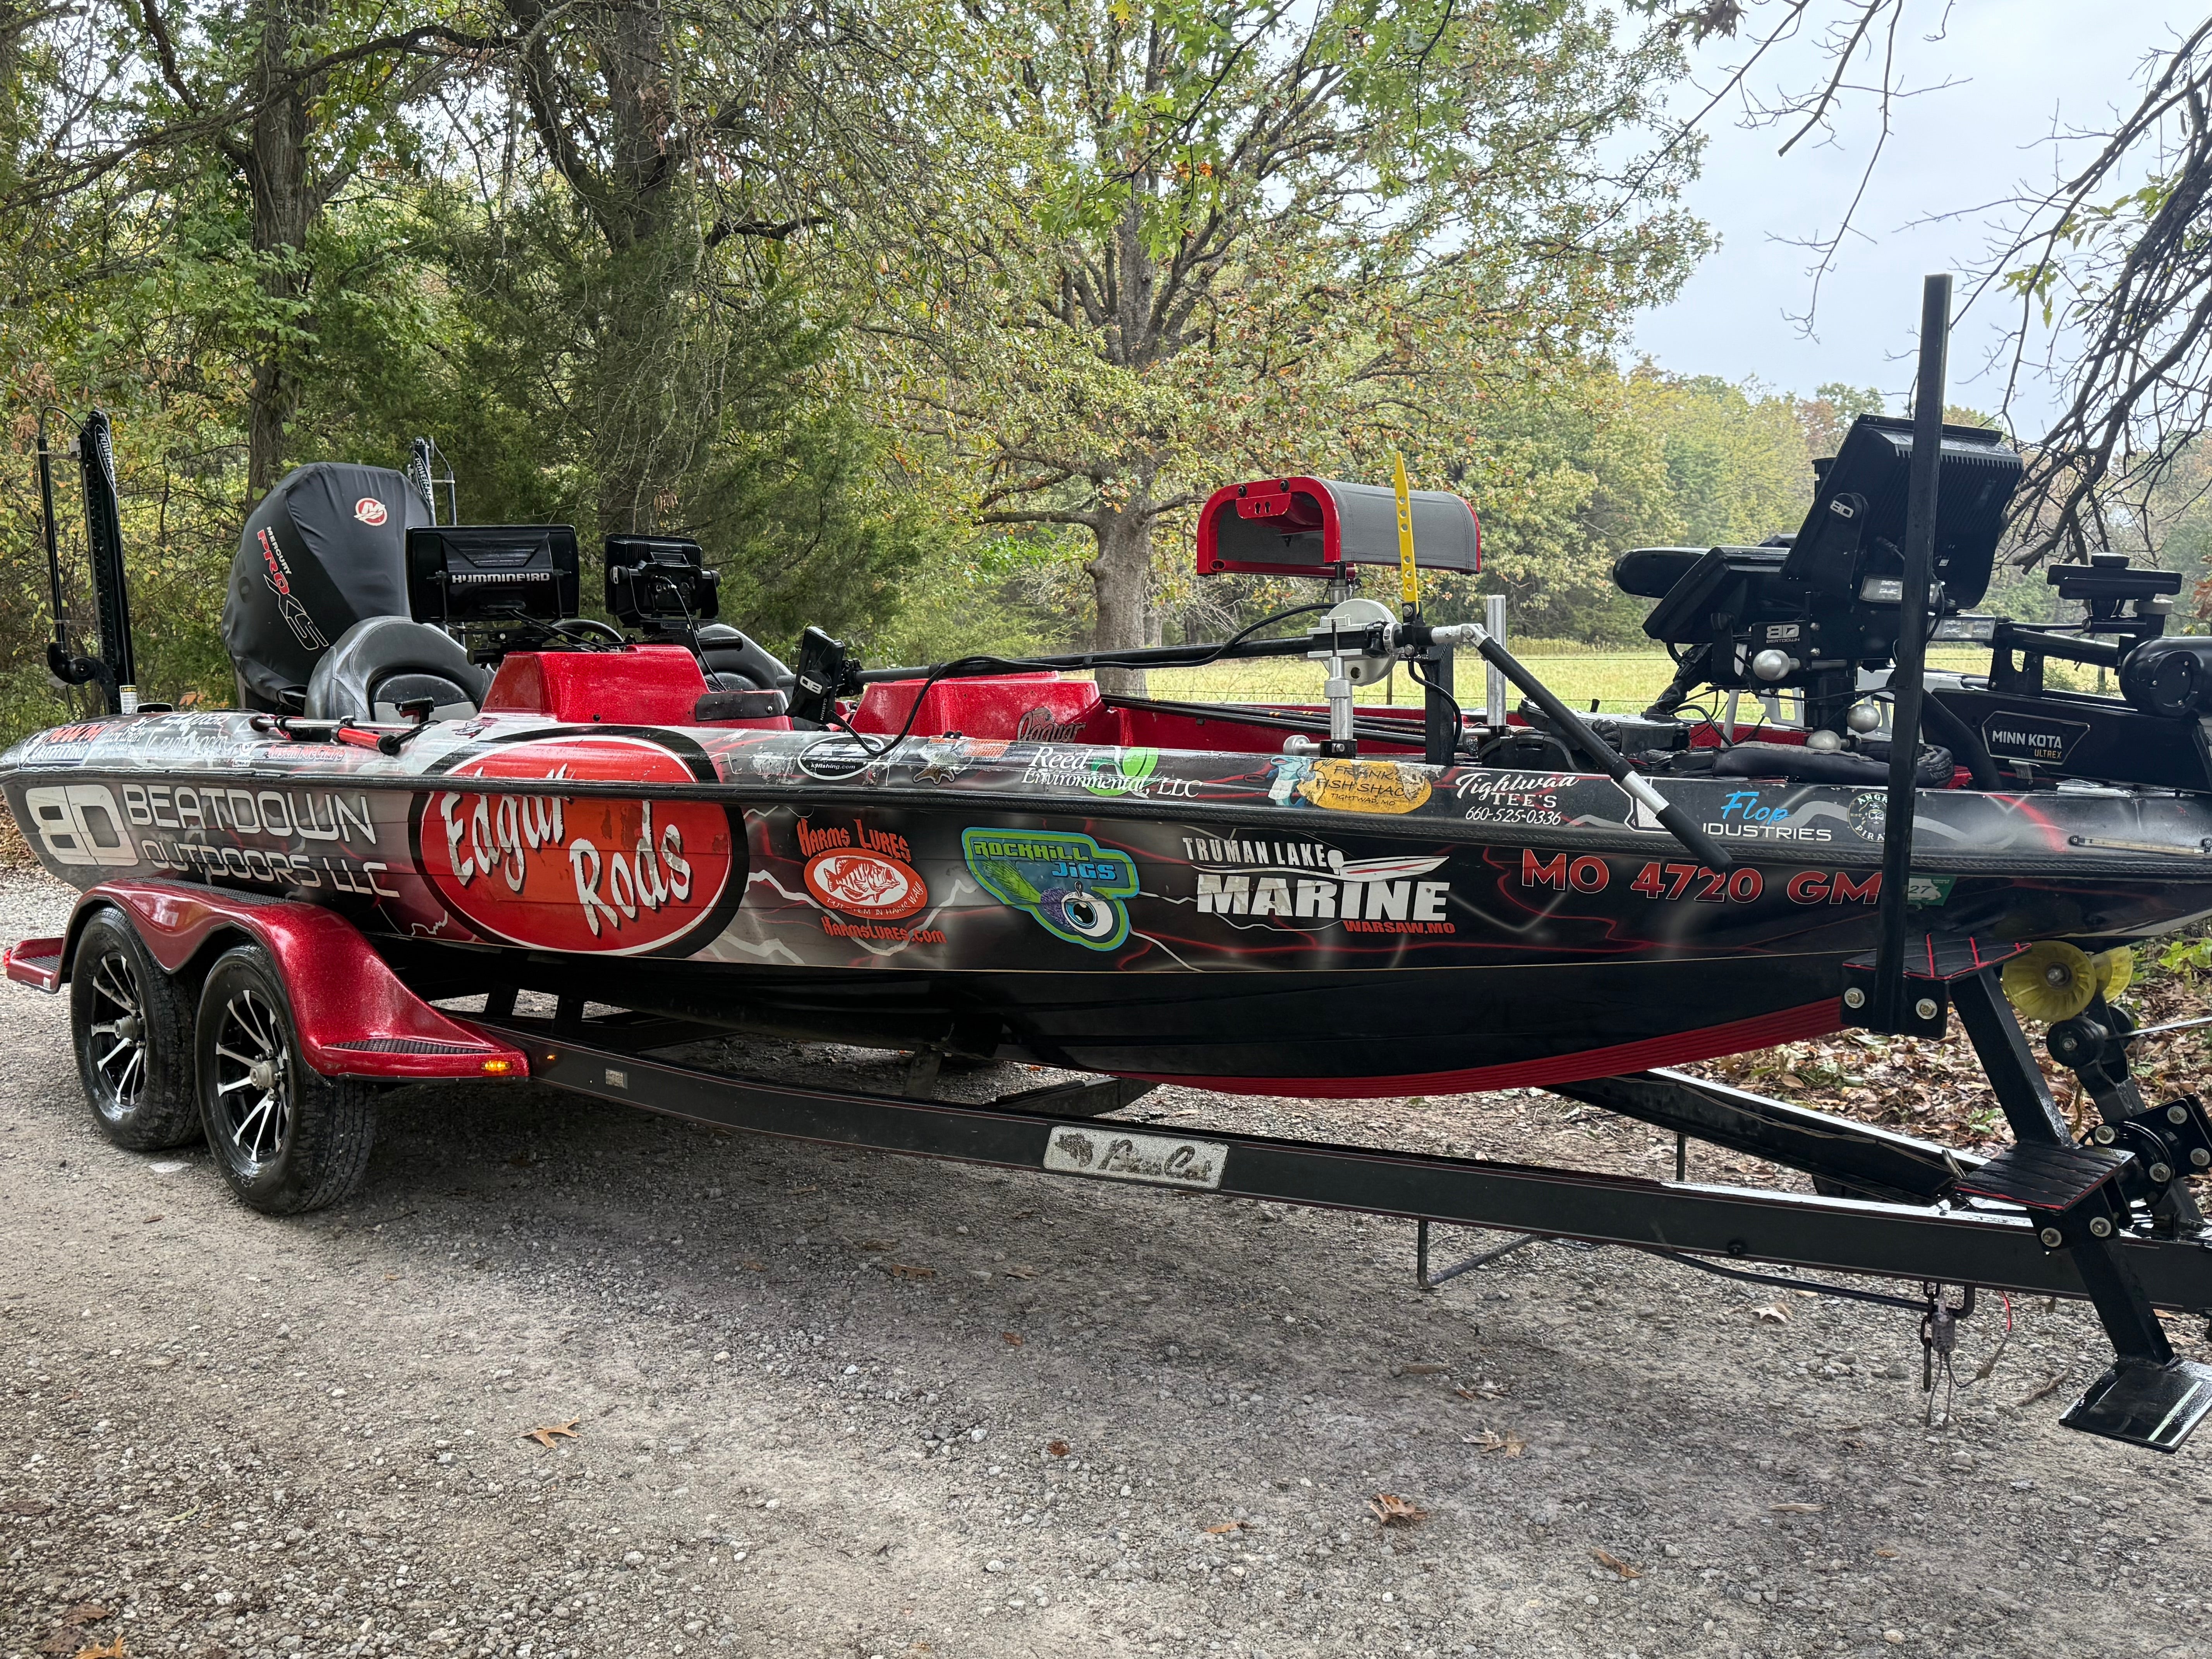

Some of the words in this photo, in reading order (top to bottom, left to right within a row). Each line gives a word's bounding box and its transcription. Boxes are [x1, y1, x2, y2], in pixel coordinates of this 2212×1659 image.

[266, 526, 292, 574] MERCURY
[257, 529, 290, 594] PRO
[452, 573, 550, 583] HUMMINBIRD
[819, 698, 828, 721] GARMIN
[1992, 730, 2025, 745] MINN
[2028, 733, 2062, 749] KOTA
[1028, 746, 1094, 770] Reed
[2034, 749, 2062, 759] ULTREX
[811, 762, 855, 770] k9fishing.com
[1157, 776, 1204, 798] LLC
[1357, 783, 1419, 799] SHAC
[1331, 793, 1379, 804] TIGHTWAD,
[1491, 792, 1557, 808] TEE'S
[1721, 790, 1793, 826] Flop
[1857, 793, 1888, 805] ANGR
[121, 784, 377, 845] BEATDOWN
[1465, 806, 1562, 826] 660-525-0336
[1855, 824, 1885, 841] PIRA
[1182, 836, 1270, 865] TRUMAN
[1276, 841, 1327, 868] LAKE
[141, 840, 321, 888] OUTDOORS
[323, 857, 400, 898] LLC
[569, 800, 690, 936] Rods
[1522, 848, 1610, 894] MO
[1630, 862, 1763, 903] 4720
[1786, 870, 1883, 905] GM
[1196, 873, 1450, 922] MARINE
[1908, 885, 1932, 894] 27
